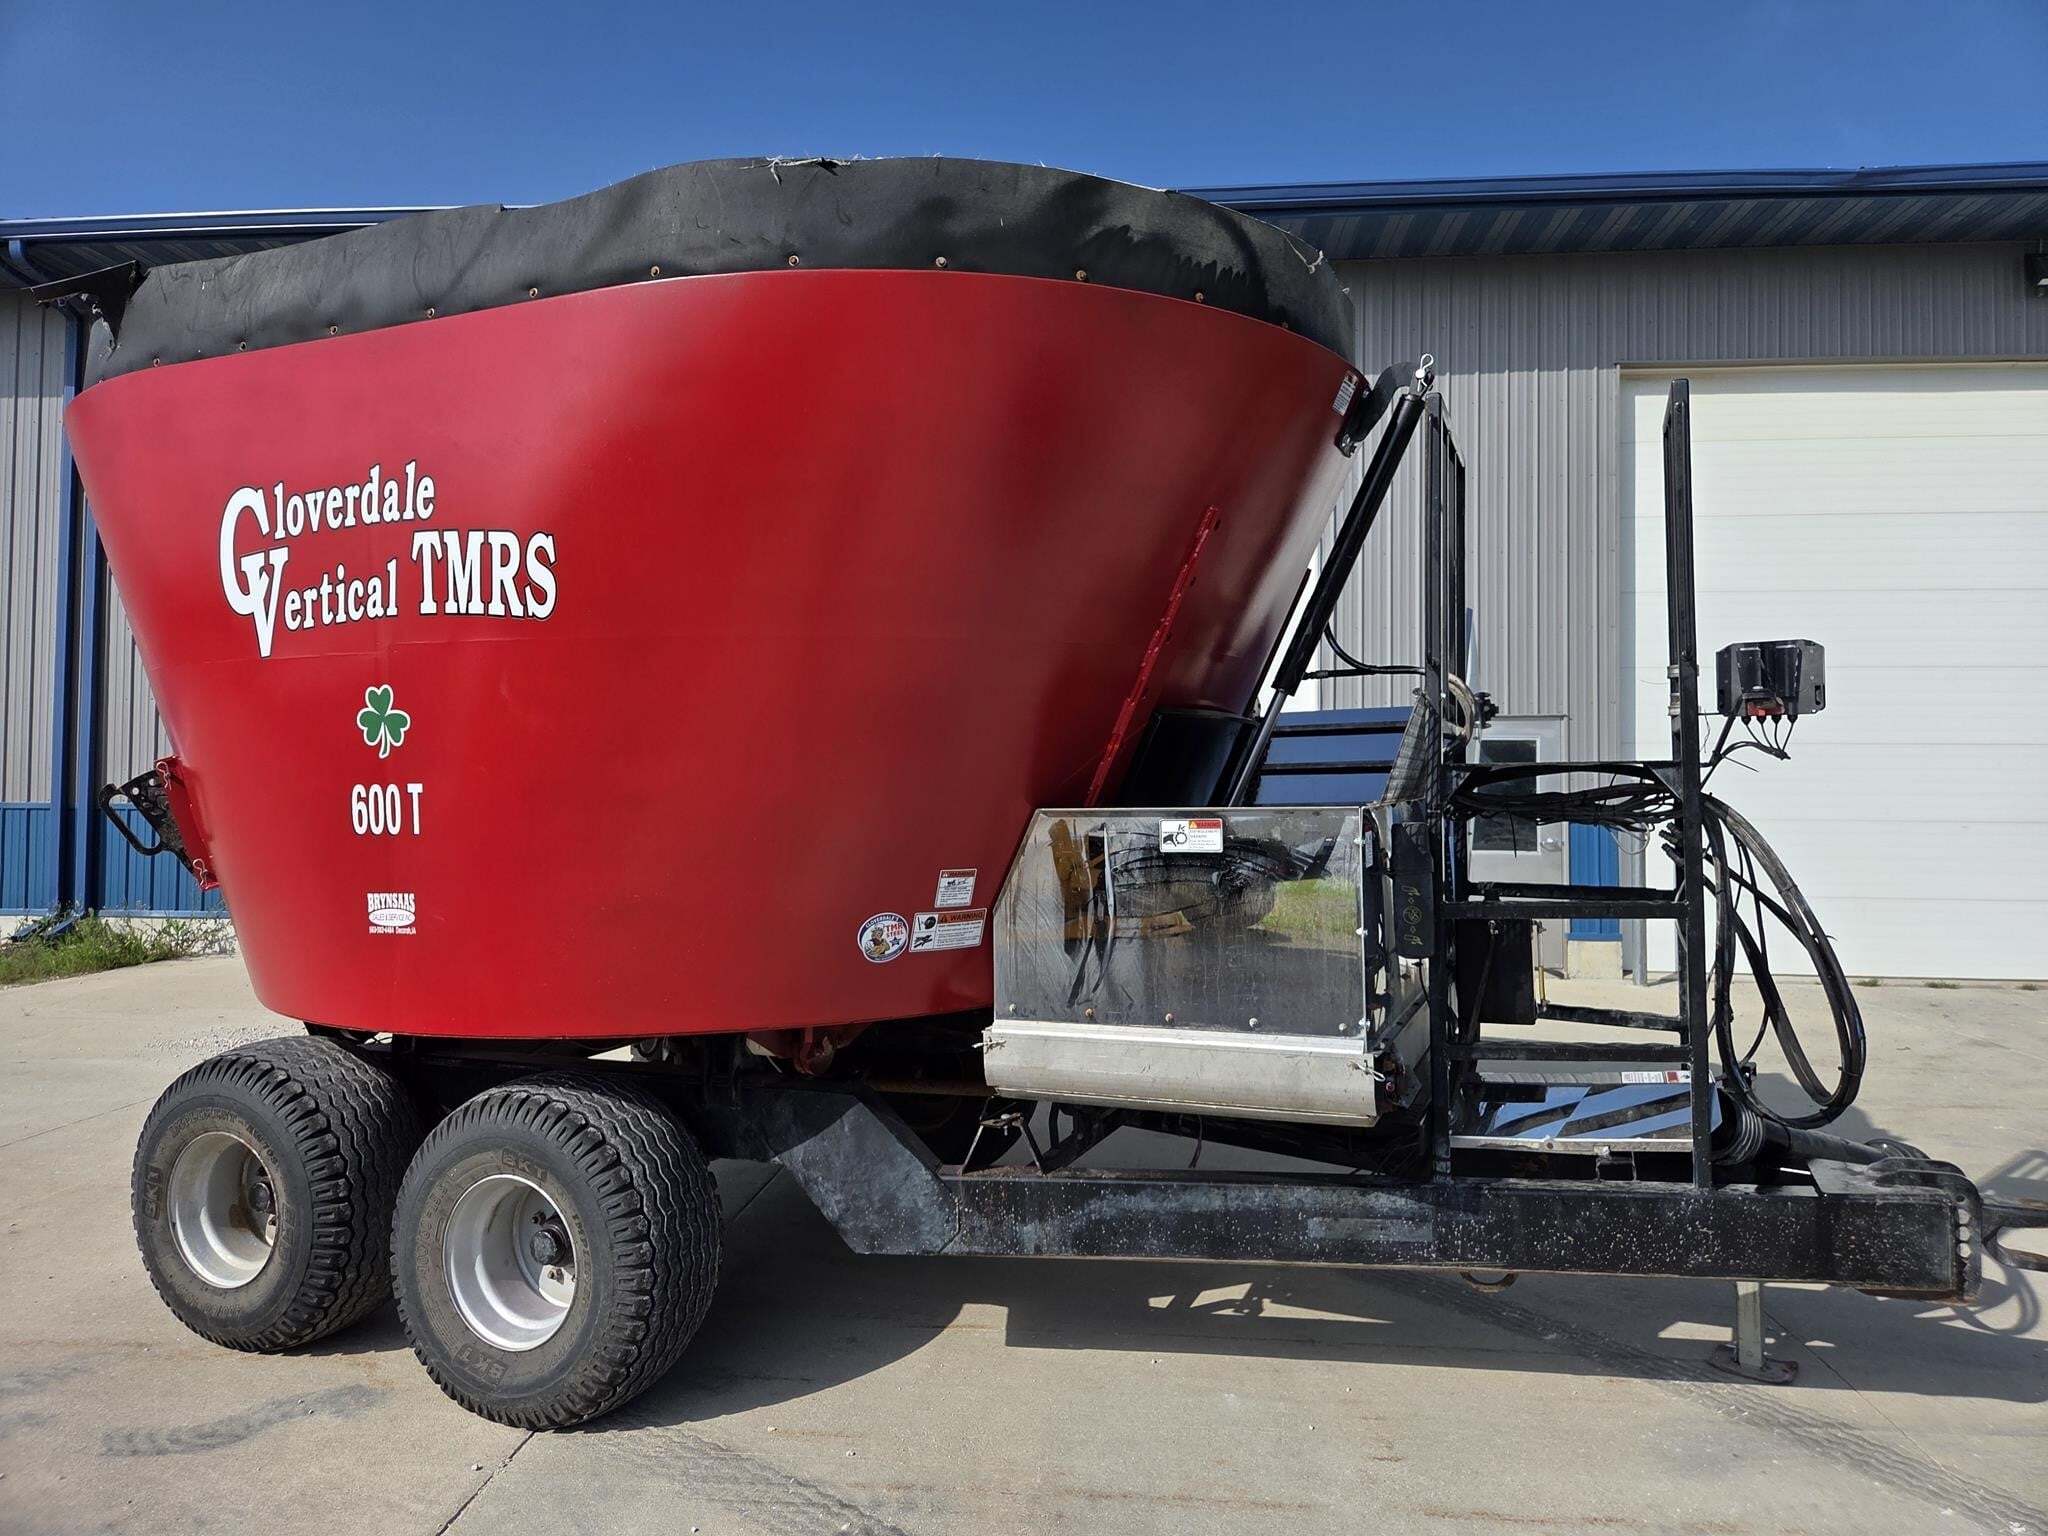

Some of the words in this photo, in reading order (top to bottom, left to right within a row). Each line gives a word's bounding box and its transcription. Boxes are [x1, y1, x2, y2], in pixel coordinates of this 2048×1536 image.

[239, 546, 399, 658] Vertical
[411, 529, 558, 620] TMRS
[351, 783, 402, 836] 600
[406, 782, 424, 836] T
[366, 892, 416, 914] BRYNSAAS
